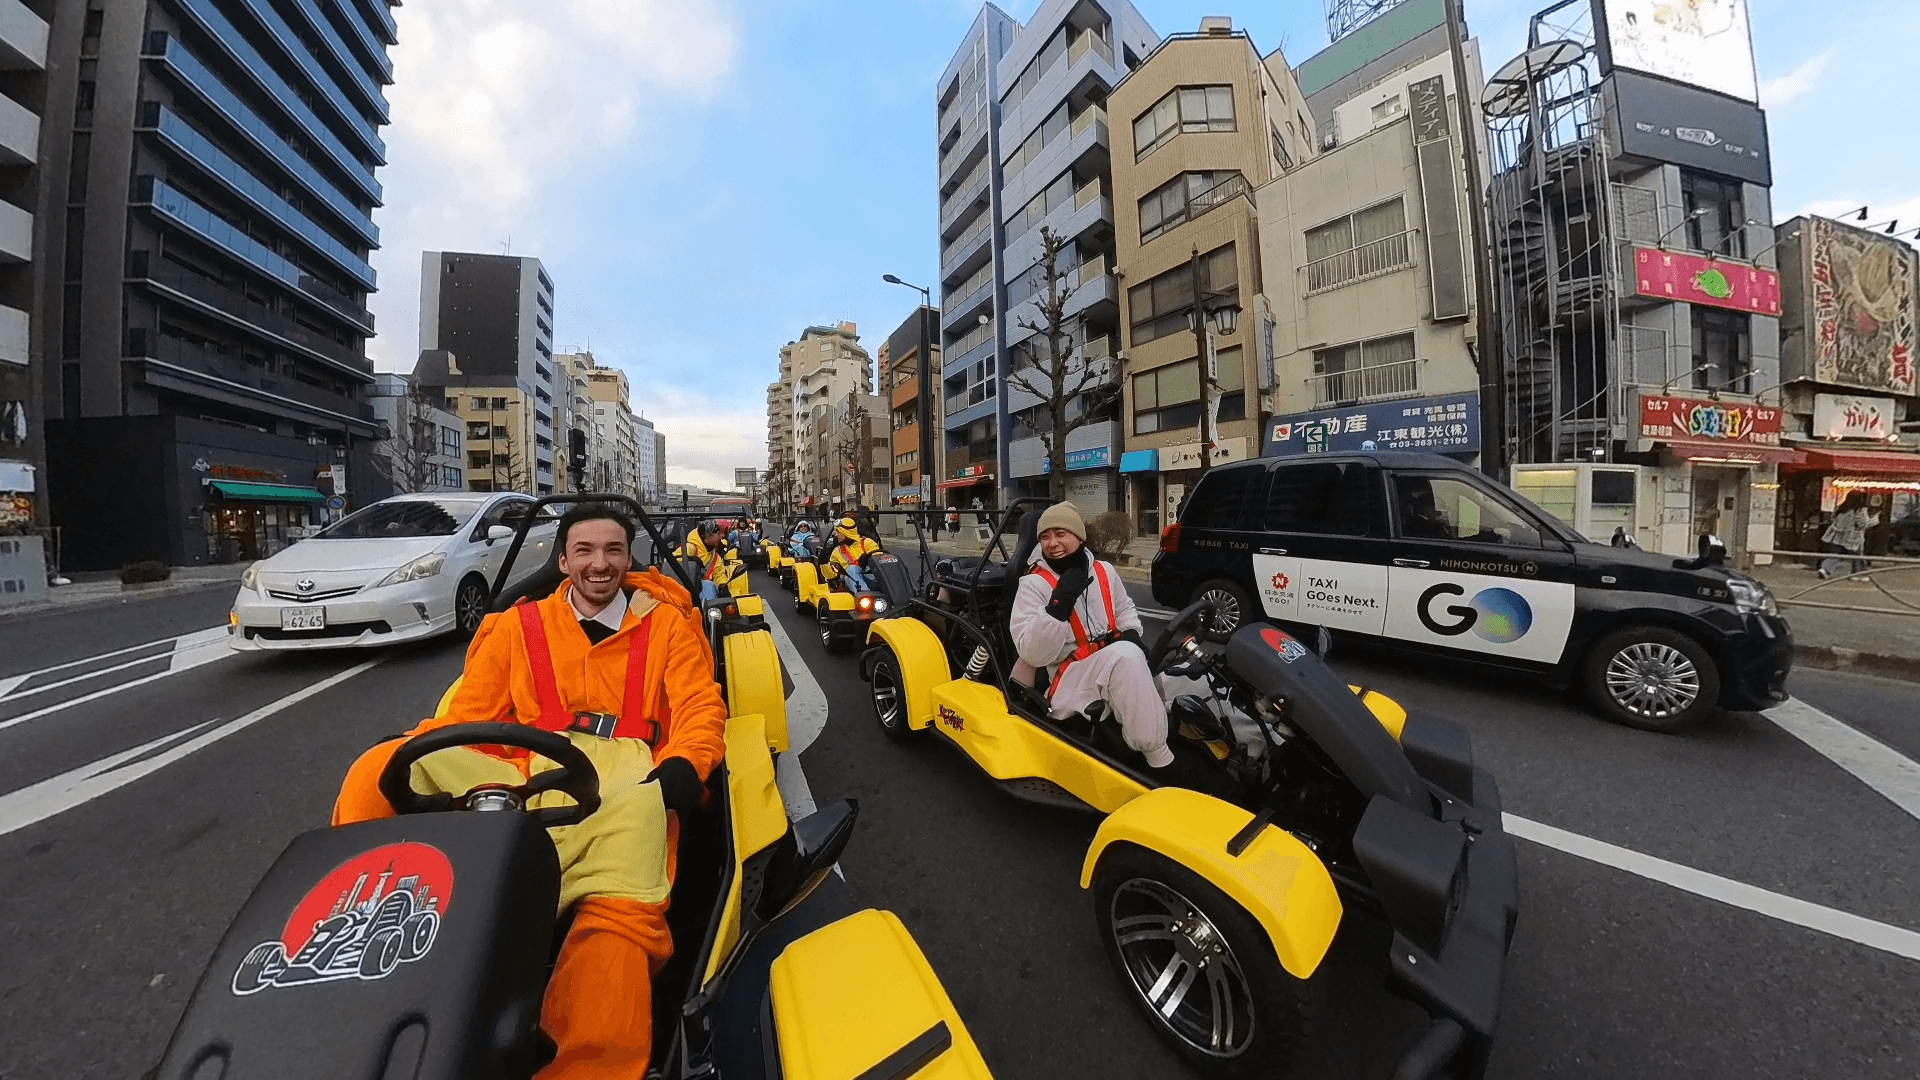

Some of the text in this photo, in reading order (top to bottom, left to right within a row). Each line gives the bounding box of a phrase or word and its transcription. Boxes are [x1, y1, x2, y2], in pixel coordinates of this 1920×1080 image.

[1646, 399, 1669, 411] セルフ
[1689, 404, 1741, 437] SELF
[1756, 409, 1775, 421] セルフ
[1293, 414, 1368, 438] 不動産
[1229, 541, 1249, 550] TAXI
[1440, 558, 1518, 574] NIHONKOTSU
[1308, 577, 1338, 590] TAXI
[1306, 590, 1379, 609] GOes Next.
